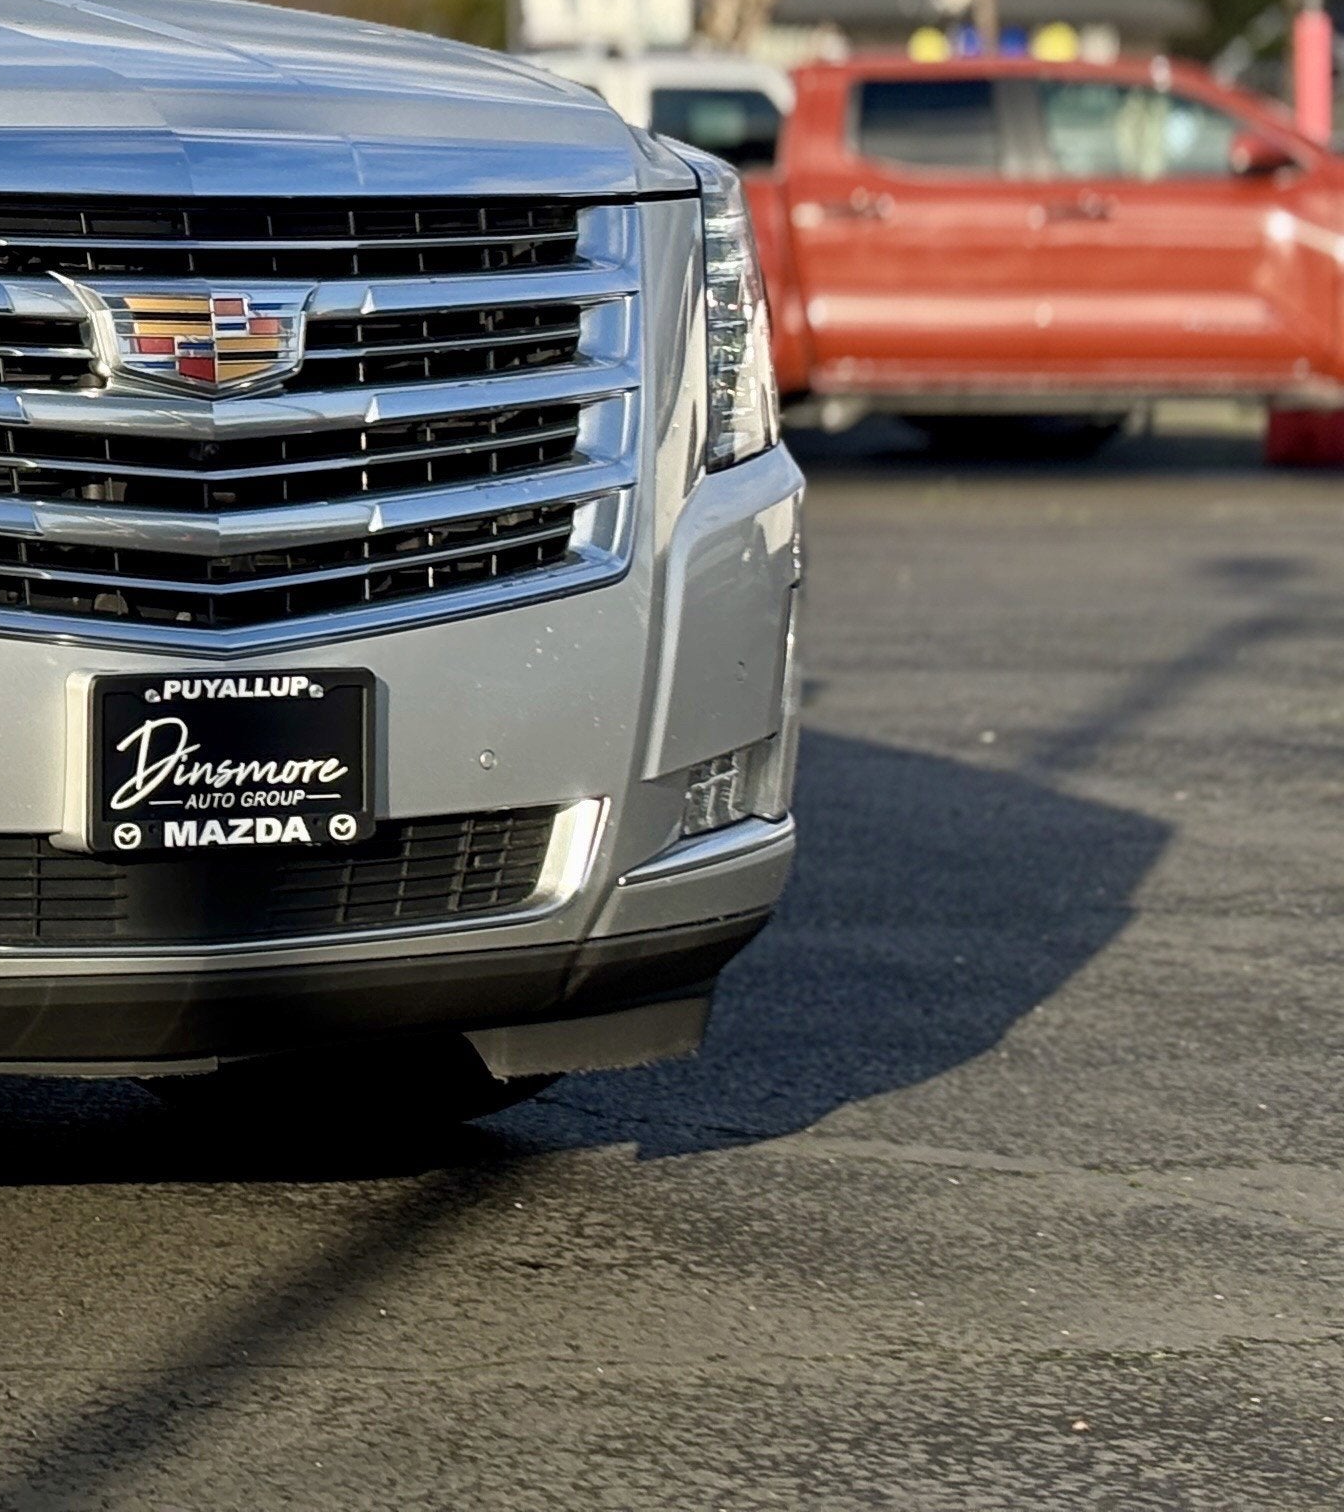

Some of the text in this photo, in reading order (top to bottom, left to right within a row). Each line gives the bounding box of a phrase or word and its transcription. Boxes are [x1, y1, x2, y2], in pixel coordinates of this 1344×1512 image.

[163, 676, 309, 700] PUYALLUP
[110, 717, 349, 810] Dinsmore
[184, 789, 306, 810] AUTO GROUP
[164, 816, 311, 847] MAZDA
